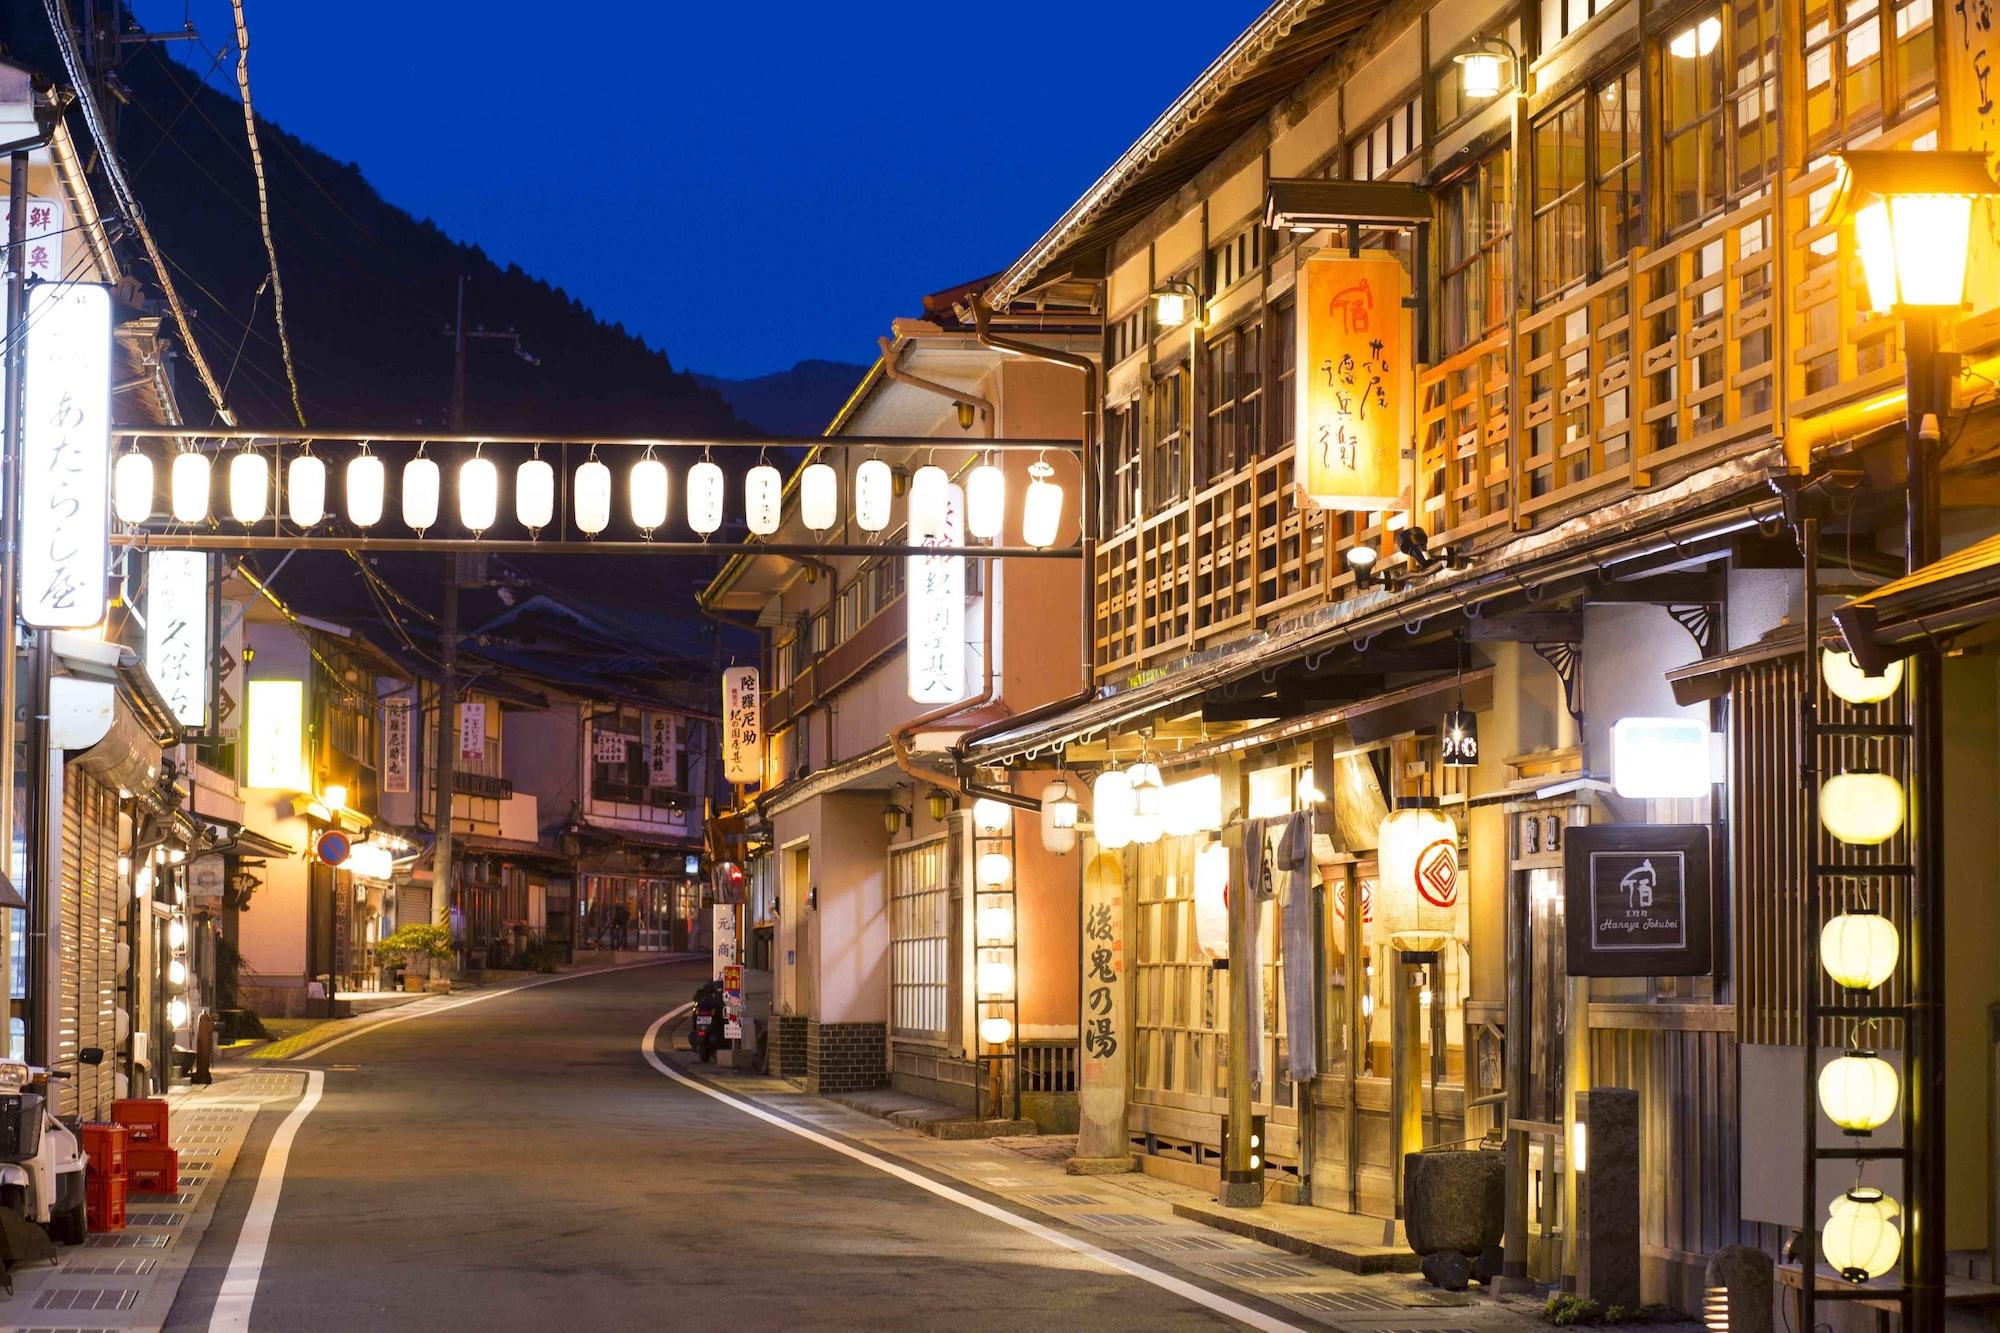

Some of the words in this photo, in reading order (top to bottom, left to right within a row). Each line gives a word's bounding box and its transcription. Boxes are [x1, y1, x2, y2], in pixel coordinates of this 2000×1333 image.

[1330, 278, 1373, 335] 宿
[40, 391, 86, 609] あたらし屋
[740, 675, 757, 746] 陀羅尼助
[1620, 858, 1657, 909] 宿
[1600, 918, 1639, 932] Hanaya
[1643, 918, 1678, 931] Tokubei
